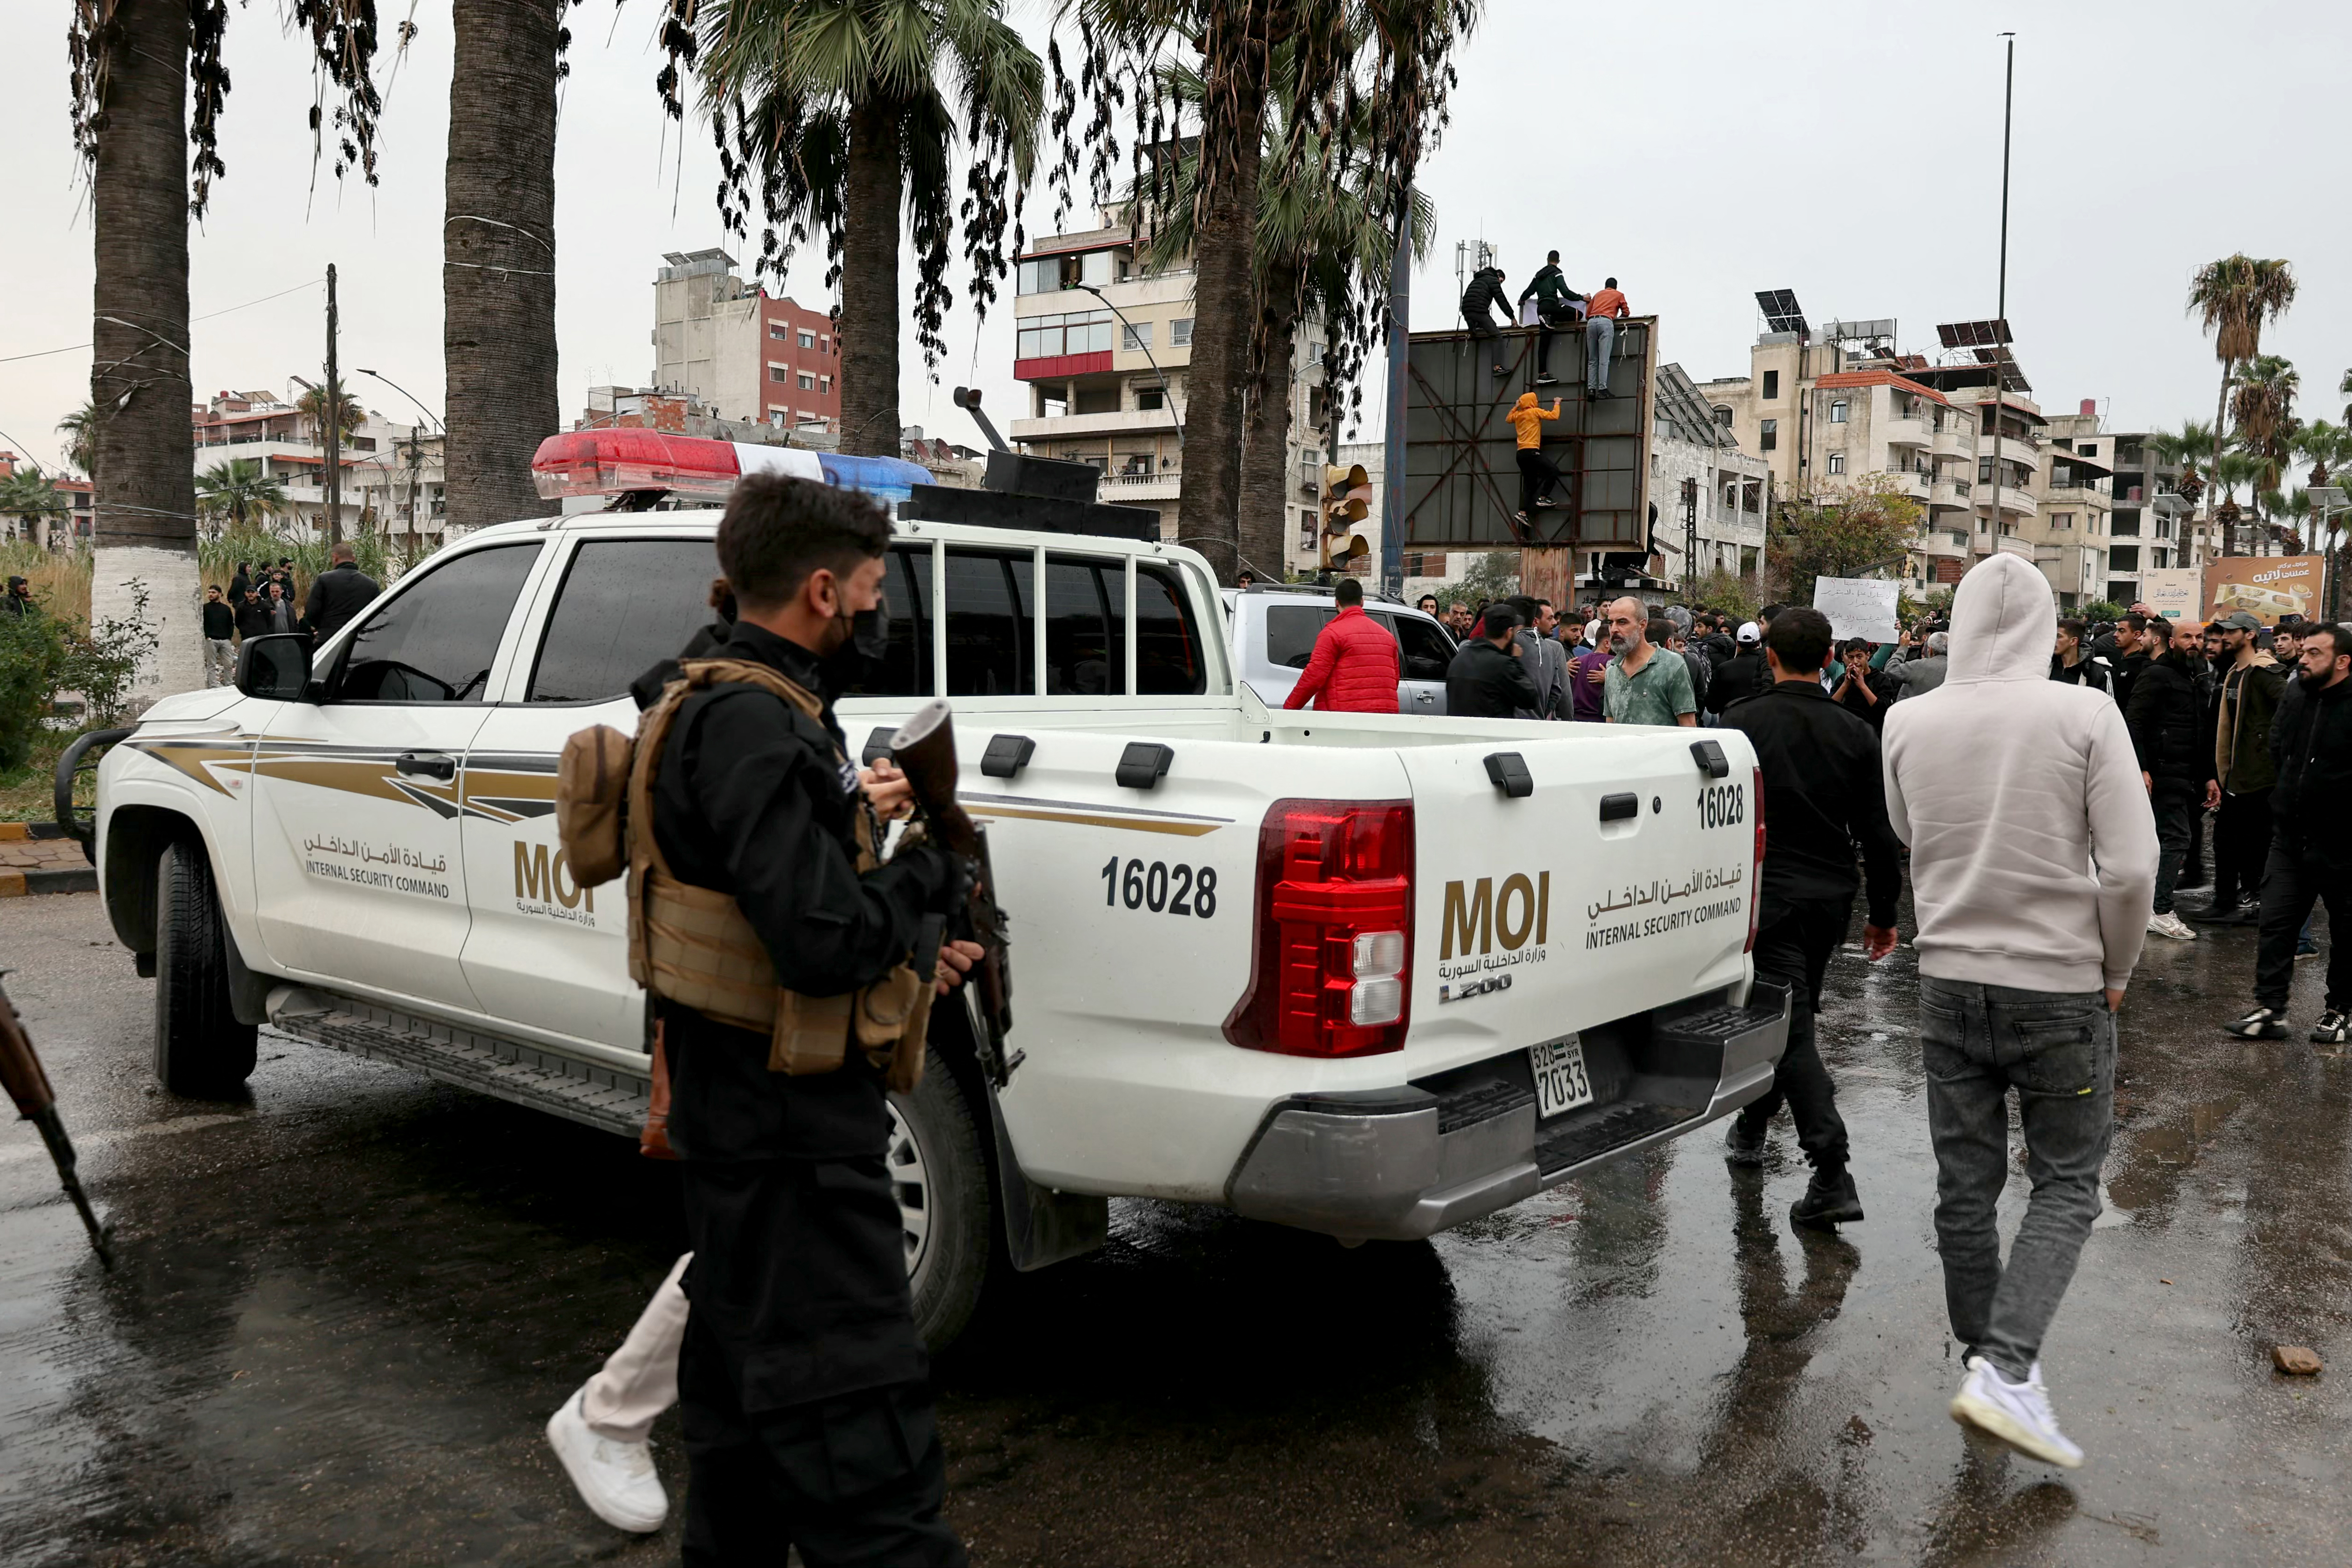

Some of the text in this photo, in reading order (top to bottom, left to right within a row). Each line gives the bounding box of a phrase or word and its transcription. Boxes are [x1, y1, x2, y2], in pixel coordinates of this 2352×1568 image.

[2252, 569, 2280, 584] لاتيه
[1697, 784, 1743, 830] 16028
[304, 833, 446, 875] قيادة الأمن الداخلي
[306, 860, 449, 899] INTERNAL SECURITY COMMAND
[1102, 856, 1217, 919] 16028
[1588, 862, 1742, 927] قيادة الأمن الداخلي
[517, 899, 595, 927] وزارة الداخلية السورية
[1439, 870, 1549, 961] MOI
[1586, 897, 1741, 949] INTERNAL SECURITY COMMAND
[1439, 946, 1546, 981] وزارة الداخلية السورية
[1439, 973, 1512, 1005] L200
[1533, 1043, 1555, 1069] 528
[1565, 1039, 1577, 1048] سورية
[1567, 1048, 1579, 1059] SYR
[1538, 1060, 1588, 1110] 7033
